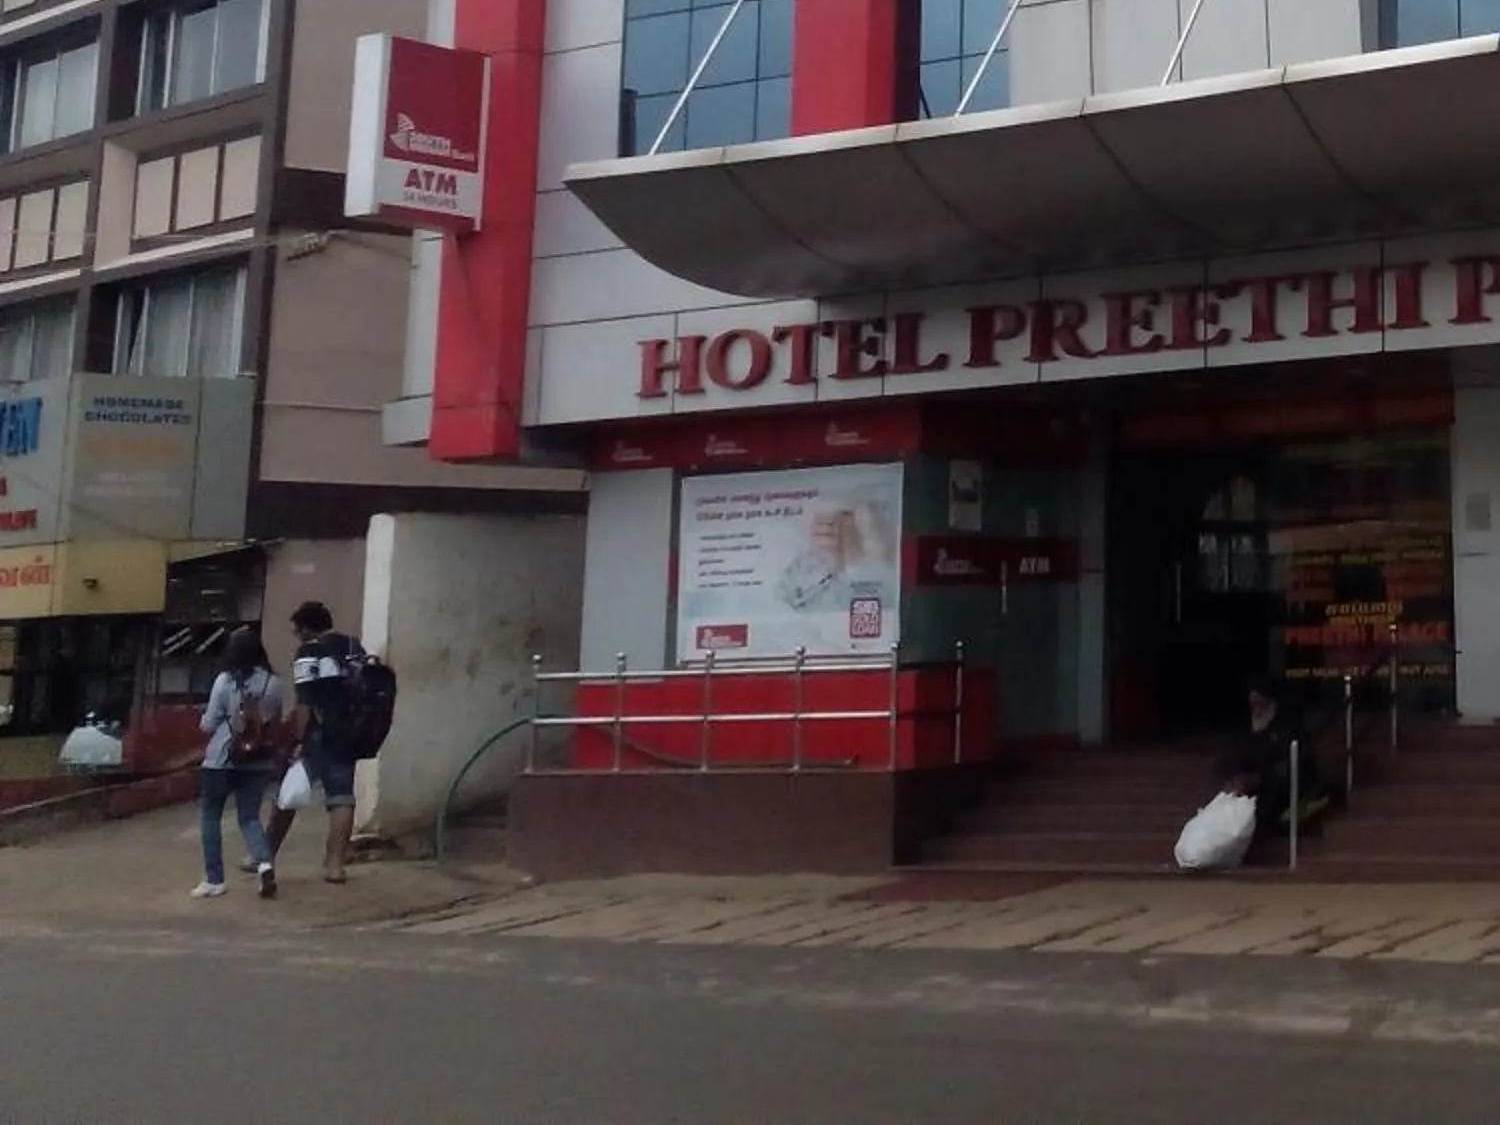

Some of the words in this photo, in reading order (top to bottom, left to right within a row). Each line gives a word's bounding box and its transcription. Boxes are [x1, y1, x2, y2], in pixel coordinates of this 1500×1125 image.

[403, 167, 458, 196] ATM
[636, 310, 949, 399] HOTEL
[961, 259, 1430, 368] PREETHI
[93, 397, 185, 410] HOMEMADE
[84, 411, 192, 425] CHOCOLATES
